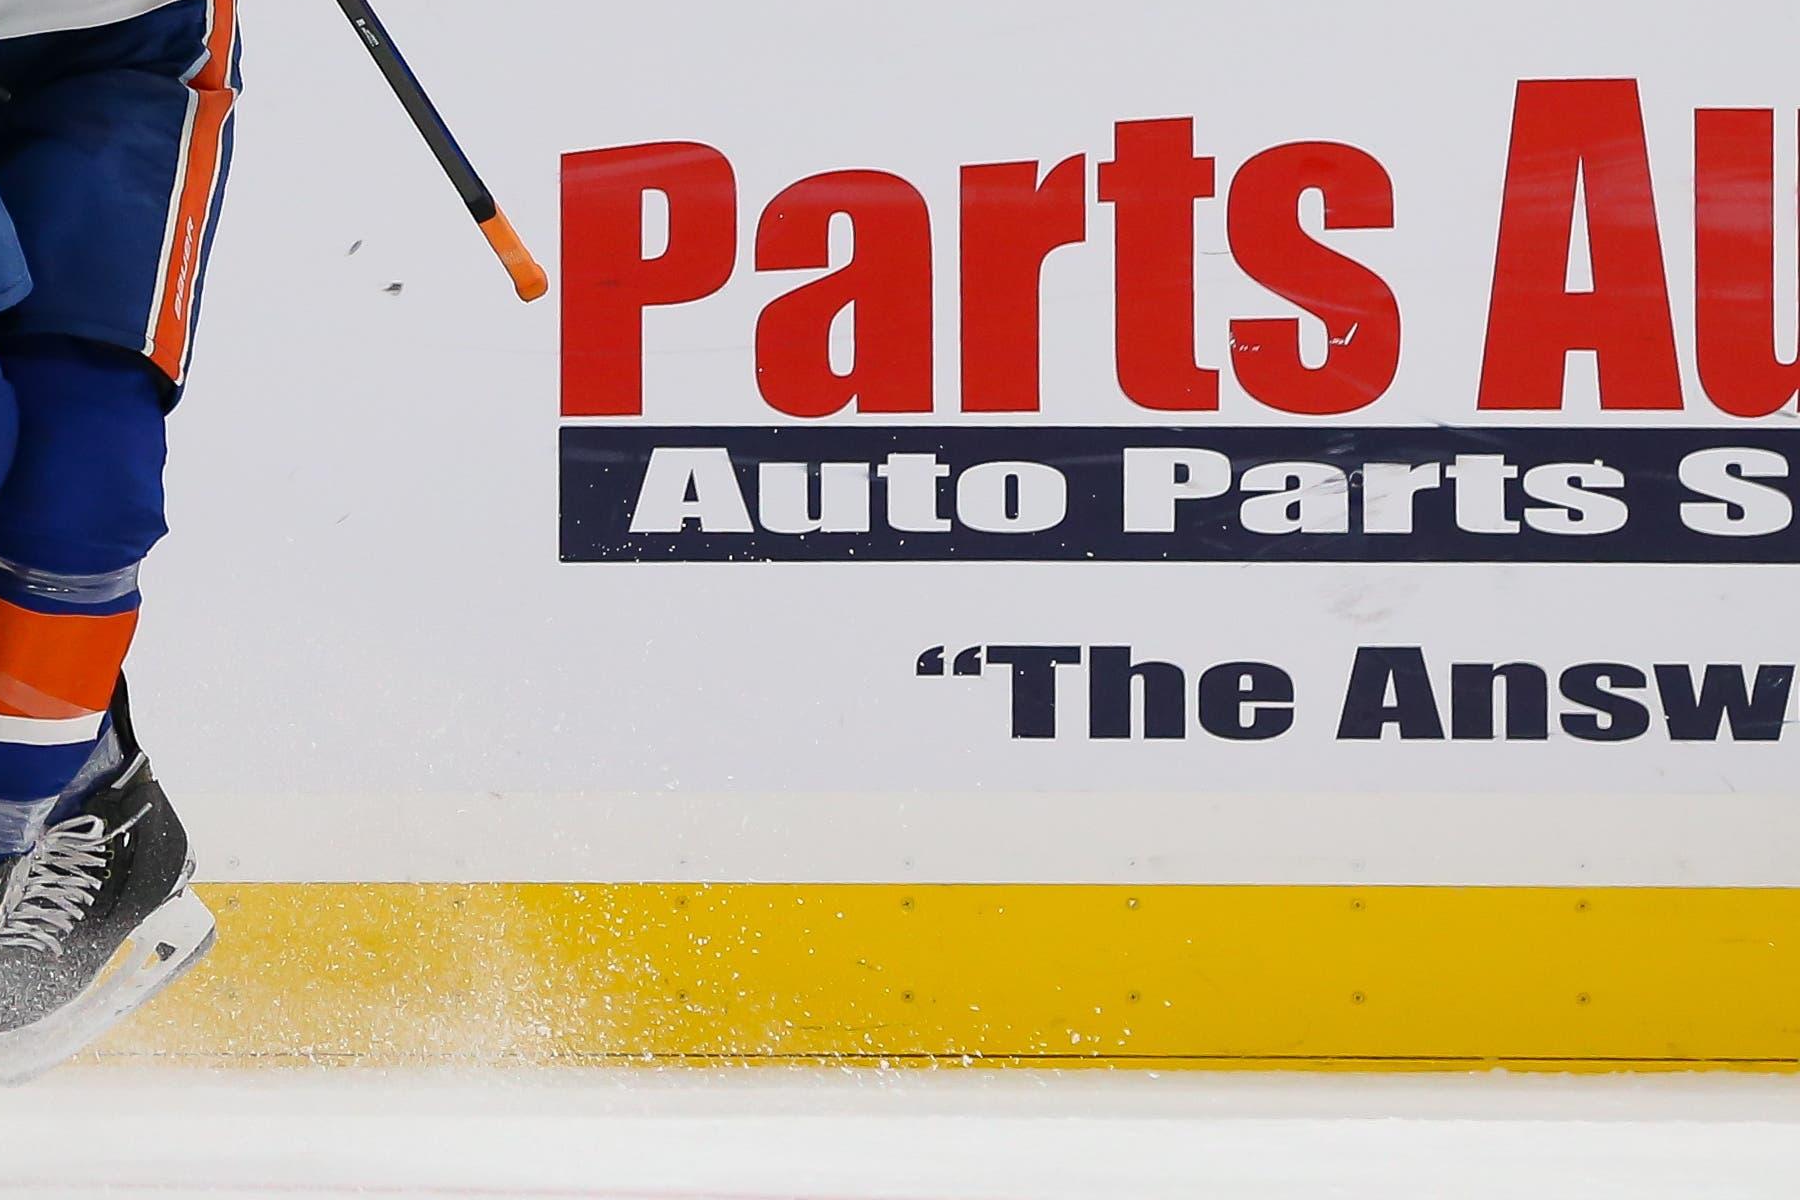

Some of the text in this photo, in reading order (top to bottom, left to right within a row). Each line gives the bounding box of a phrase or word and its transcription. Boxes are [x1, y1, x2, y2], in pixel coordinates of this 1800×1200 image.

[560, 116, 1401, 418] Parts
[628, 446, 1067, 534] Auto
[1122, 446, 1629, 536] Parts
[1336, 646, 1796, 742] Answ
